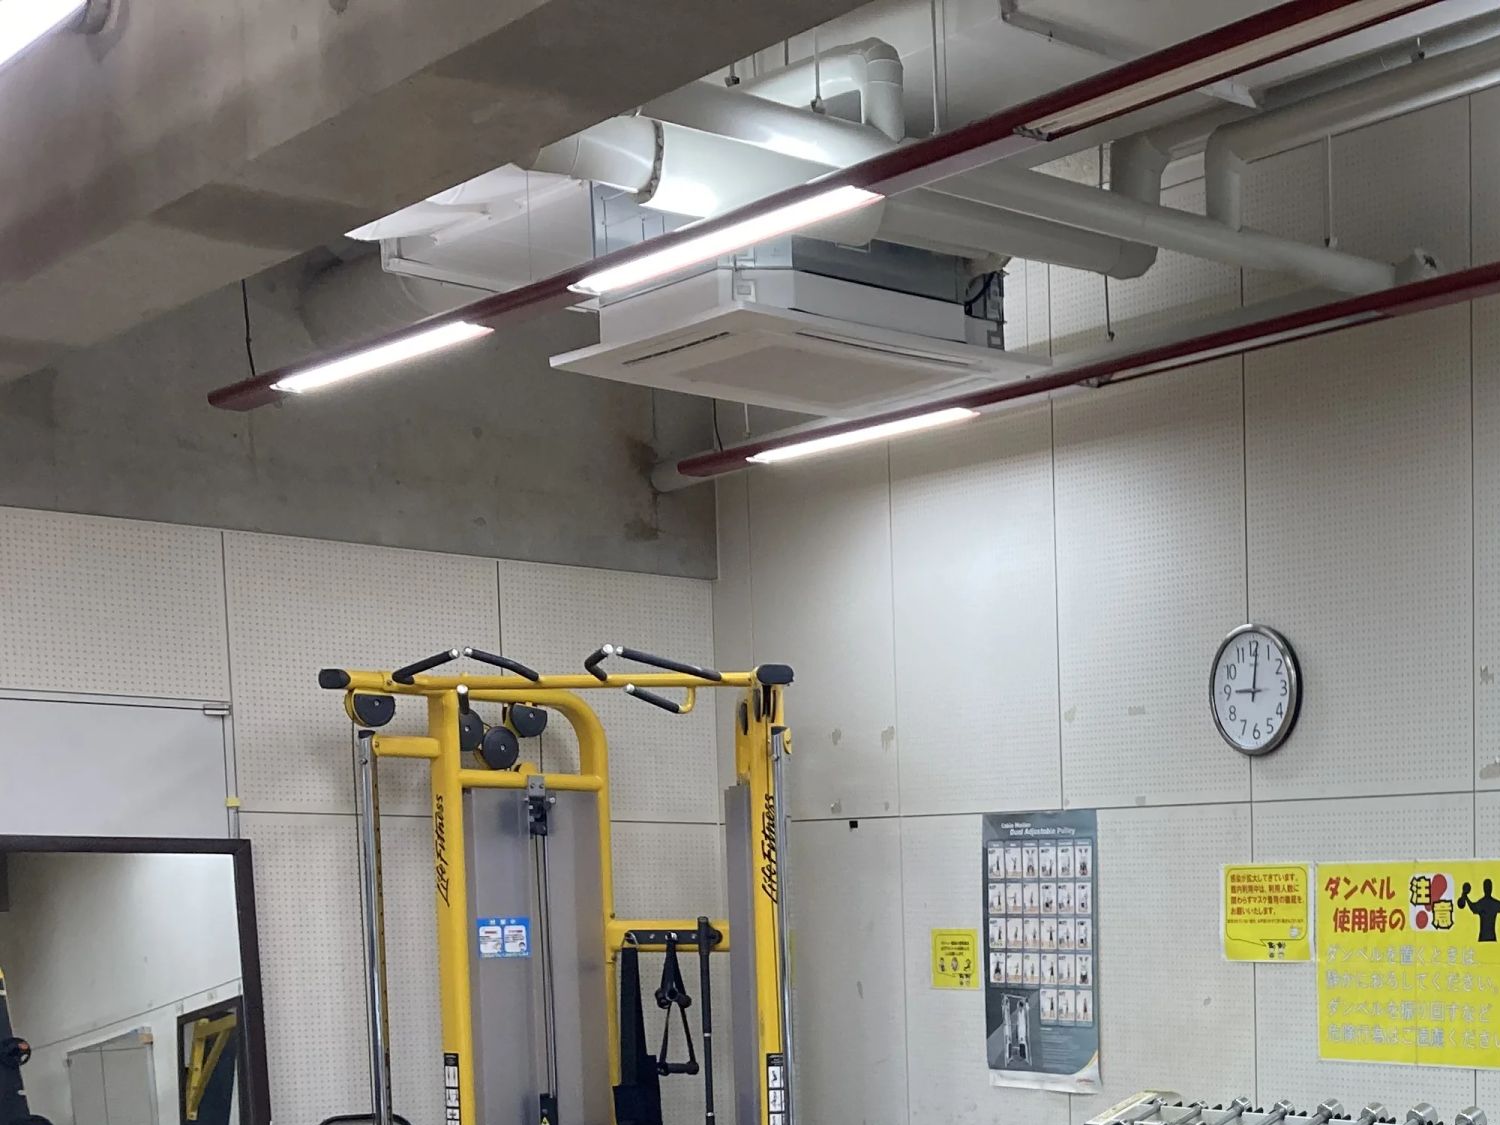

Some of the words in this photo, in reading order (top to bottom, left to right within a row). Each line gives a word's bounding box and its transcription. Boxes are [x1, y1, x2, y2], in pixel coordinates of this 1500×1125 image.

[1236, 645, 1245, 663] 11
[1225, 663, 1237, 680] 10
[1275, 658, 1283, 675] 2
[1223, 684, 1232, 701] 9
[1280, 679, 1288, 697] 3
[1228, 705, 1237, 722] 8
[1275, 702, 1283, 718] 4
[1240, 719, 1247, 736] 7
[1252, 723, 1261, 740] 6
[1266, 717, 1274, 734] 5
[1324, 876, 1396, 900] ダンベル
[1333, 907, 1406, 933] 使用時の
[1327, 998, 1493, 1022] ダンベルを振り回すなど
